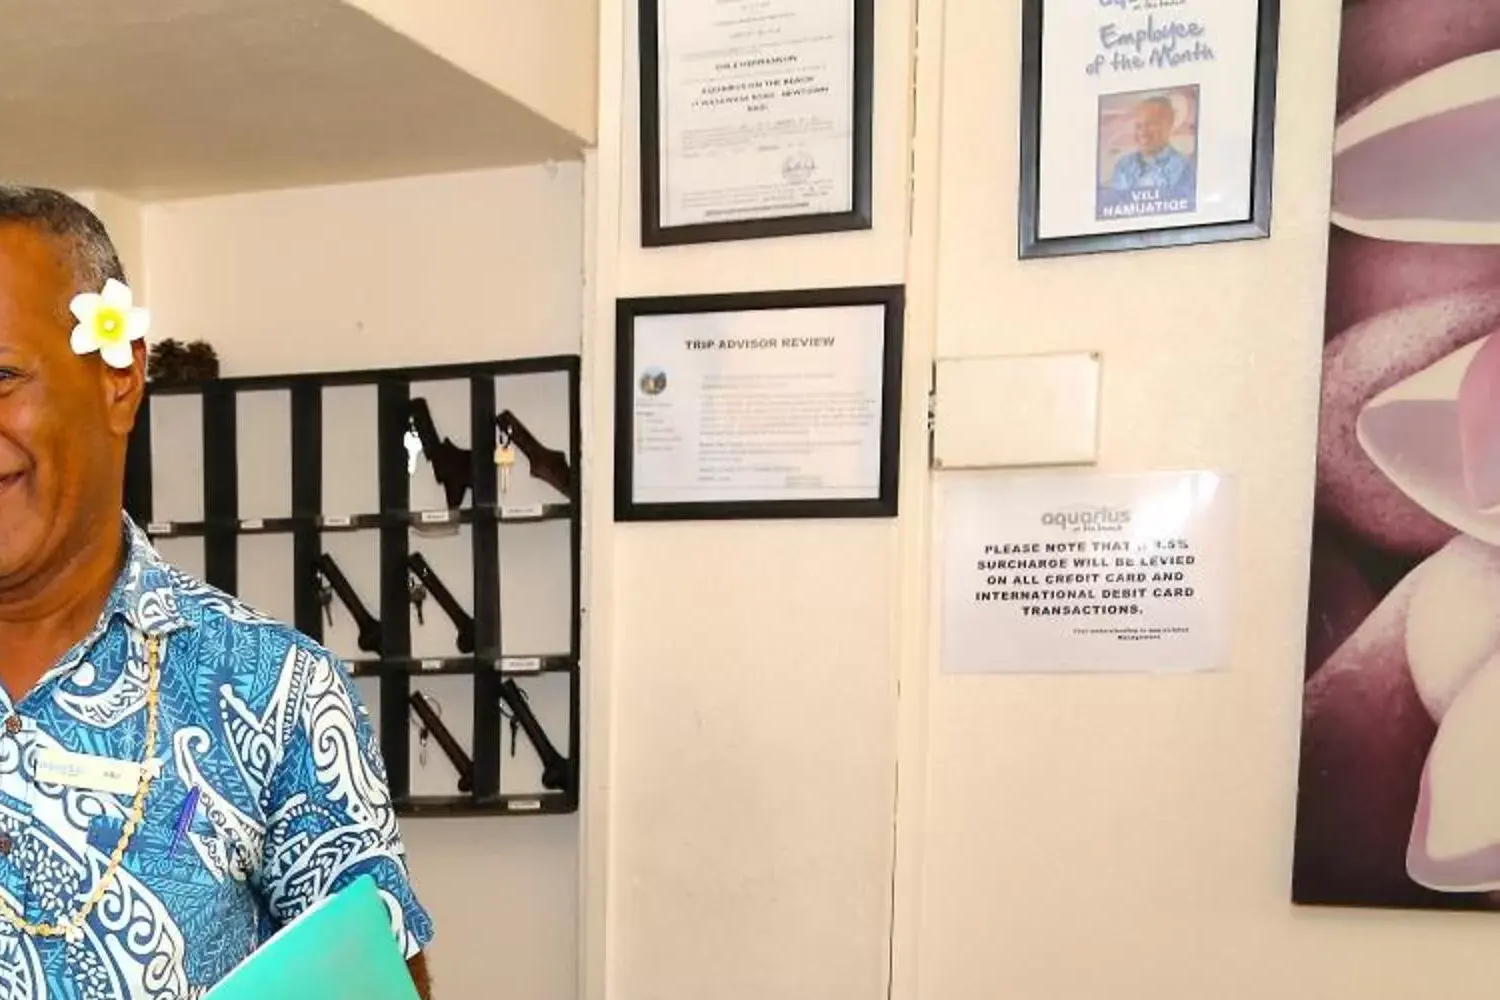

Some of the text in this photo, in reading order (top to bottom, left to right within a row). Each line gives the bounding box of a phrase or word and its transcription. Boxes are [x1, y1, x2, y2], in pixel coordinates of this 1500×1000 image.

[1099, 14, 1204, 53] Employee
[1085, 41, 1214, 75] of the Month
[684, 336, 835, 350] TRIP ADVISOR REVIEW
[1040, 505, 1131, 531] aquarius
[985, 542, 1041, 555] PLEASE
[1045, 541, 1087, 553] NOTE
[1091, 541, 1130, 553] THAT
[977, 554, 1195, 570] SURCHARGE WILL BE LEVIED
[987, 571, 1184, 586] ON ALL CREDIT CARD AND
[975, 587, 1195, 602] INTERNATIONAL DEBIT CARD
[1022, 604, 1144, 617] TRANSACTIONS.
